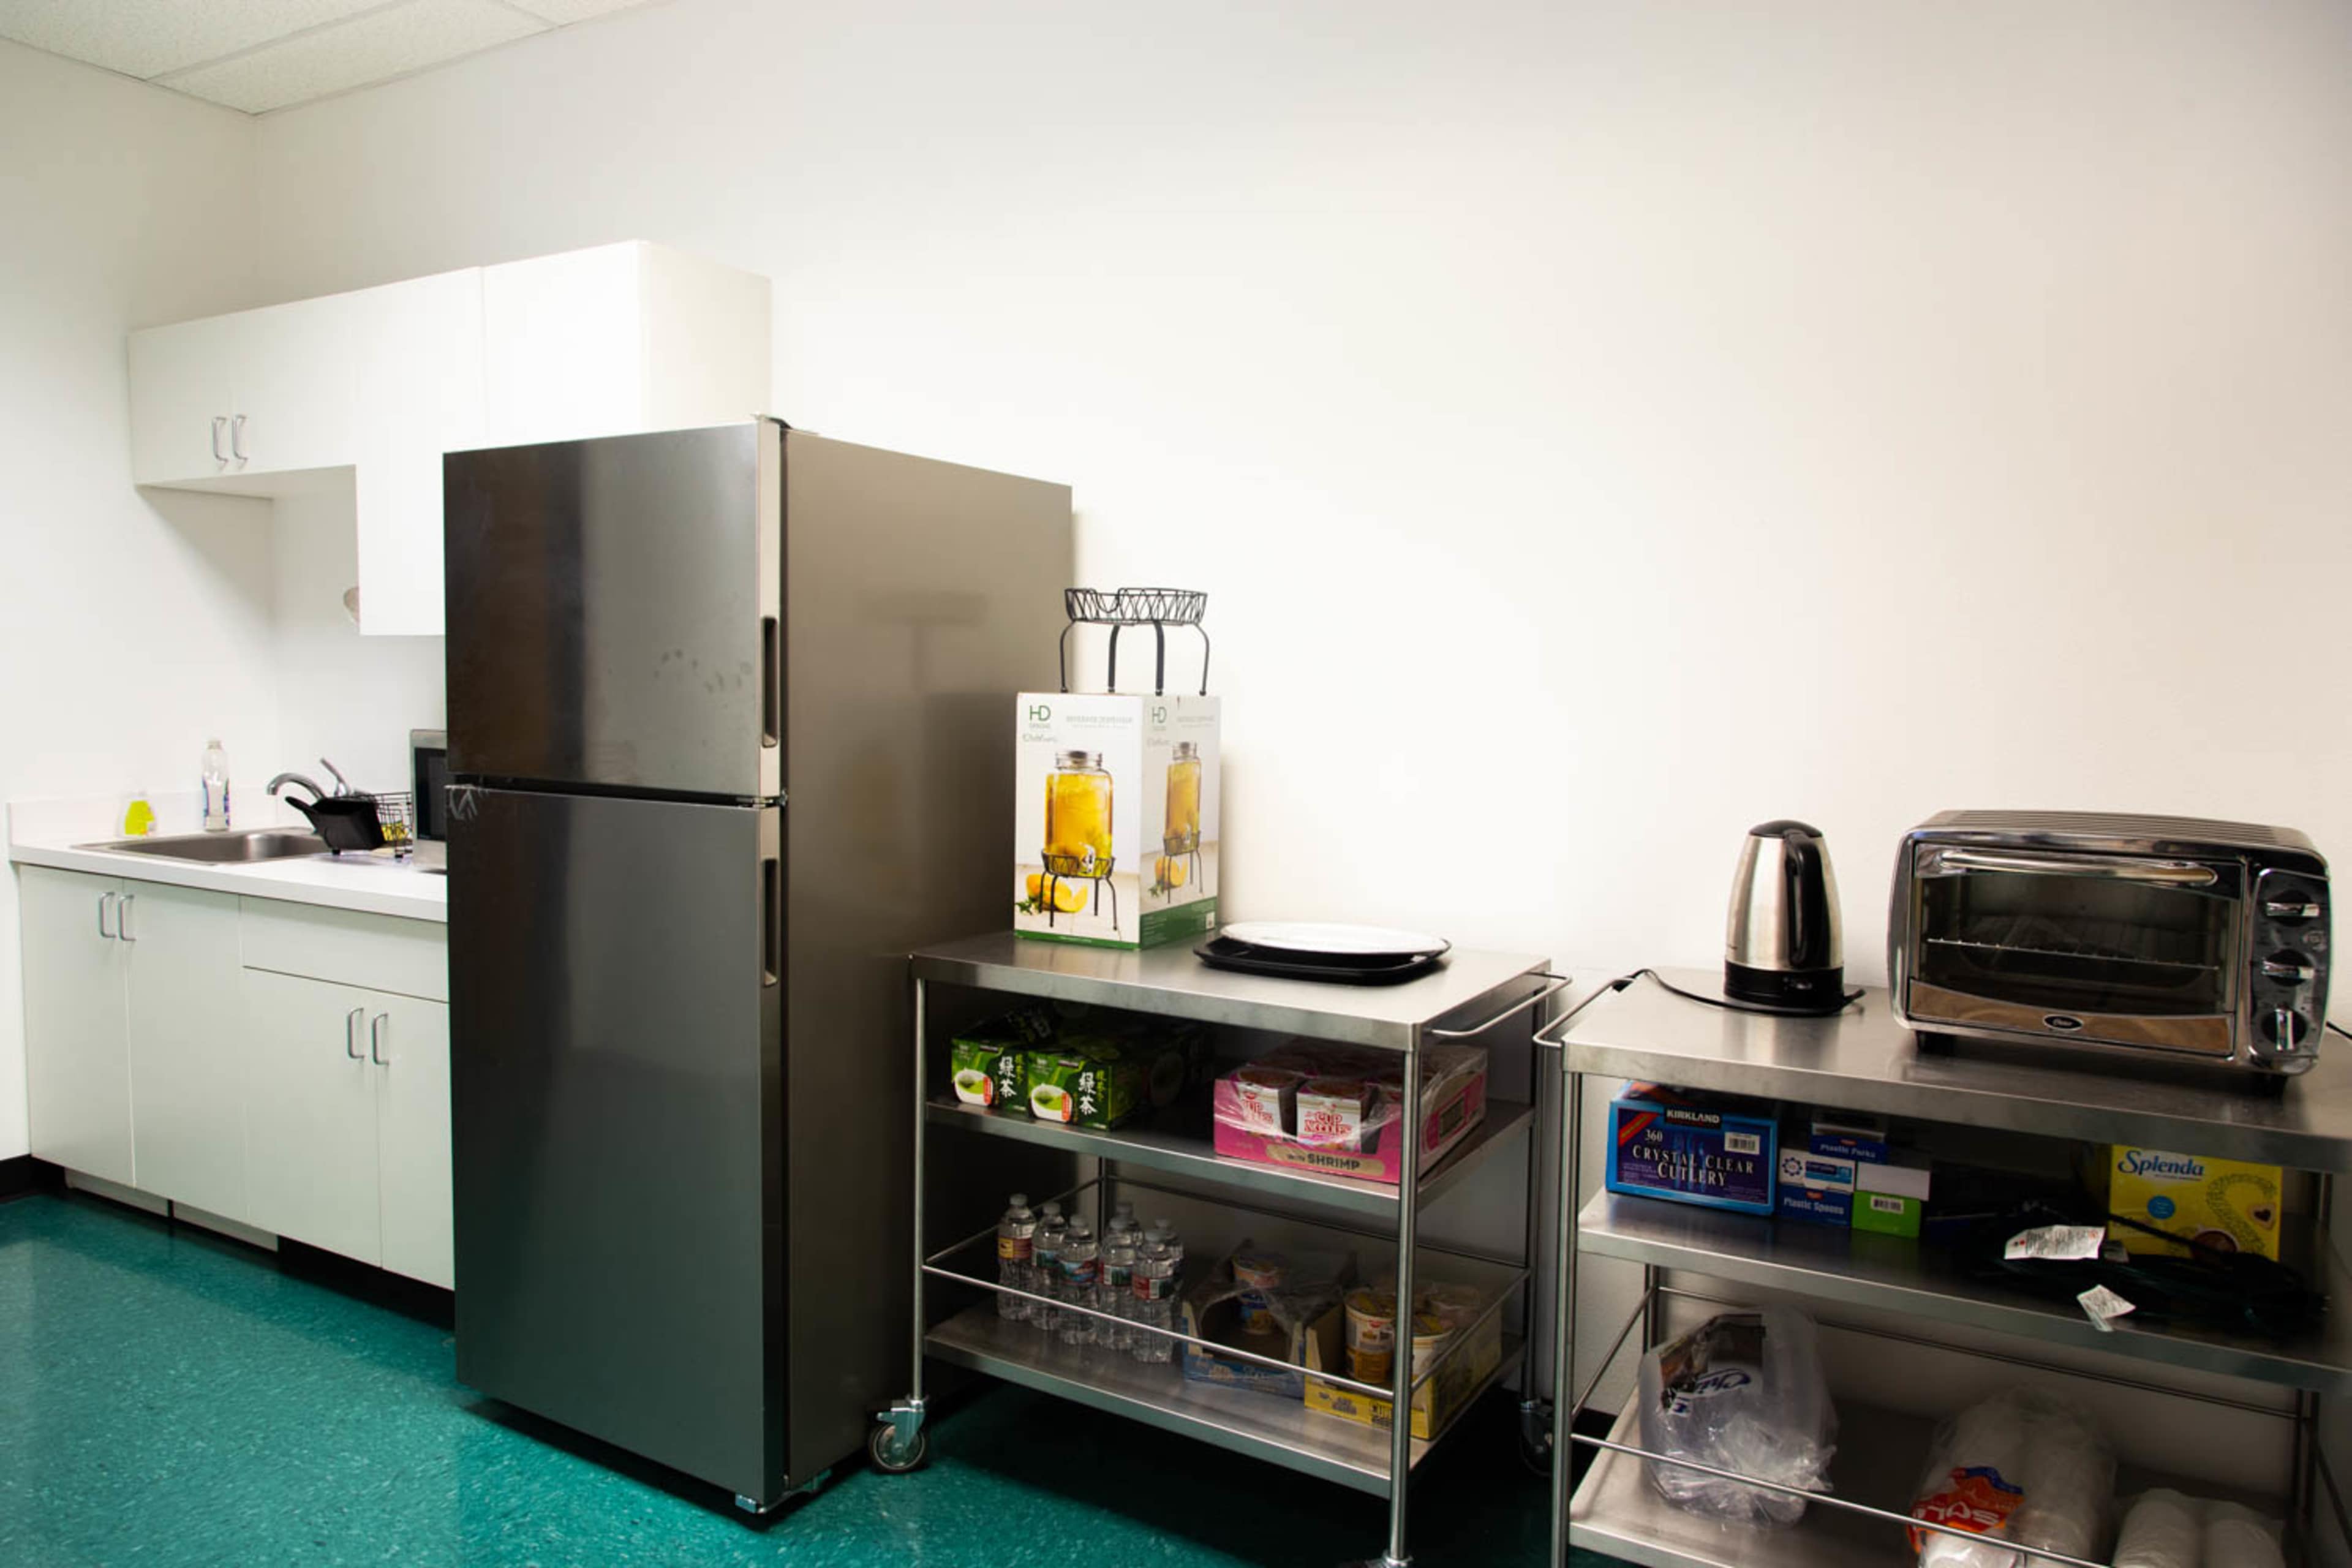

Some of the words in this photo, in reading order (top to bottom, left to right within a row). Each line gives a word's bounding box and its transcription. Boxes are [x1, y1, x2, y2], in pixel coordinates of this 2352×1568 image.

[1029, 704, 1051, 722] HD
[1152, 706, 1167, 723] HD
[1665, 1108, 1721, 1125] KIRKLAND
[1645, 1128, 1664, 1143] 360
[1307, 1153, 1361, 1170] SHRIMP
[1632, 1144, 1698, 1167] CRYSTAL
[1705, 1153, 1755, 1175] CLEAR
[2117, 1149, 2204, 1176] Splenda
[1657, 1161, 1728, 1187] CUTLERY
